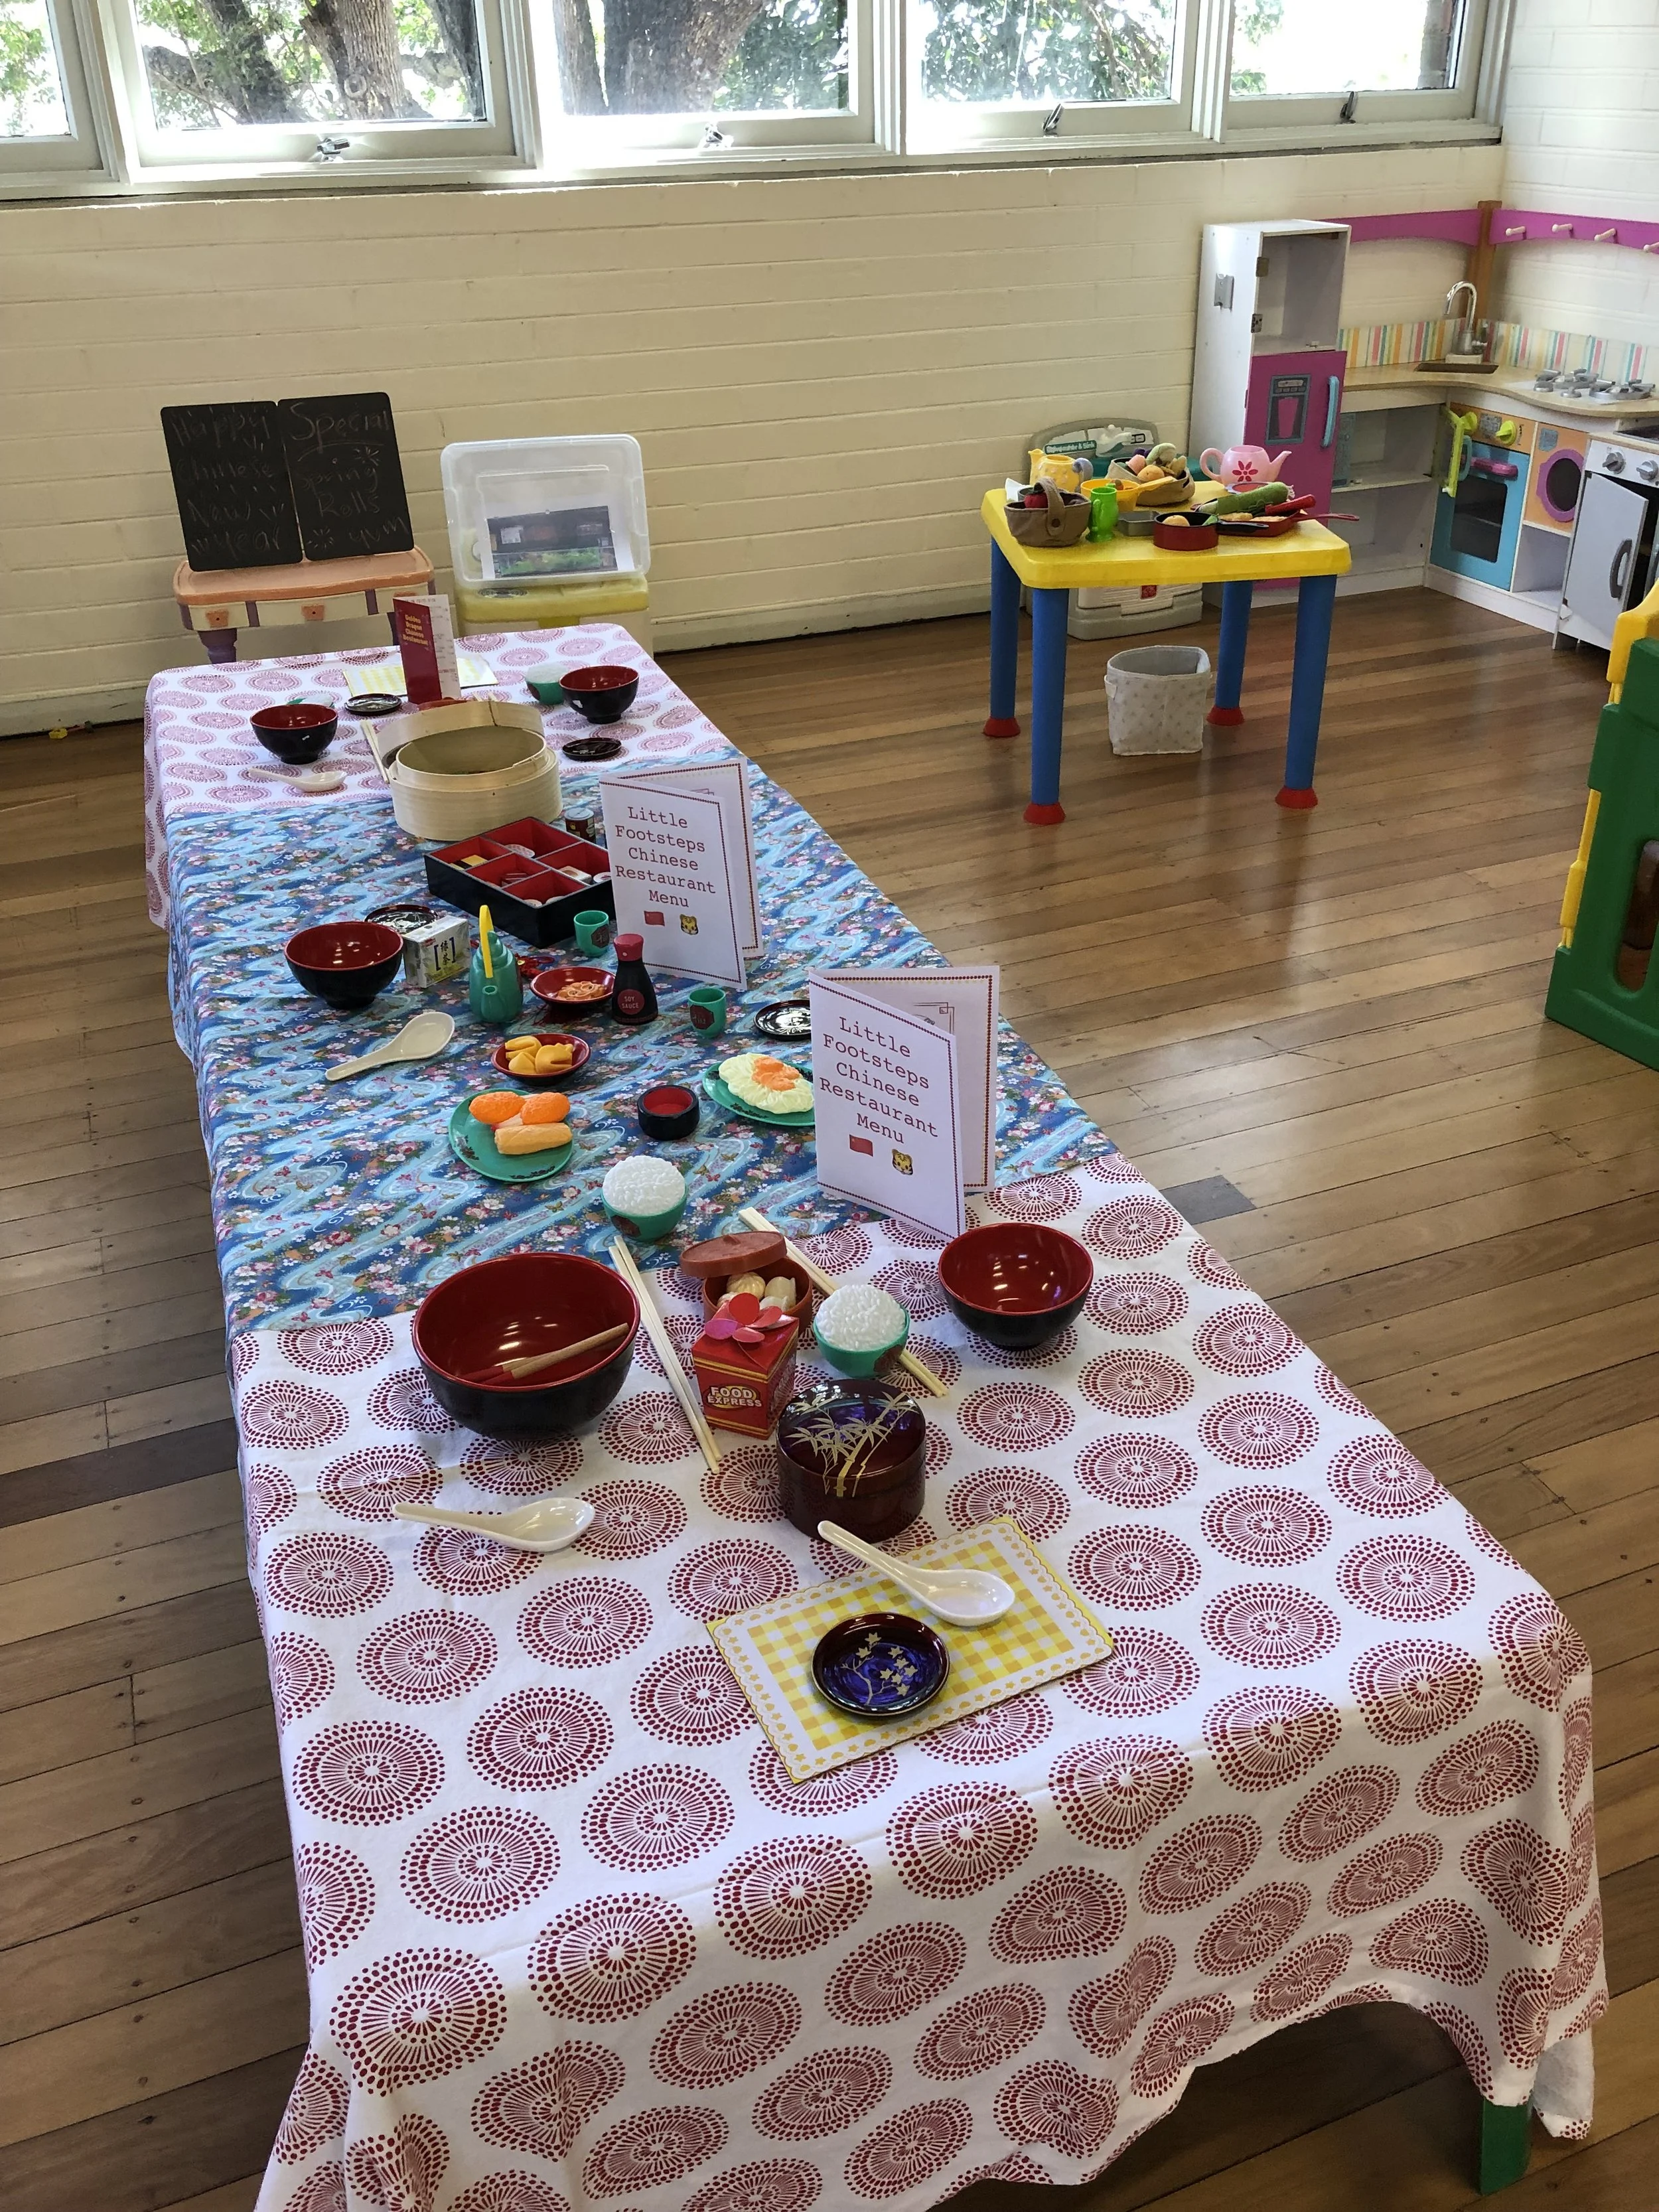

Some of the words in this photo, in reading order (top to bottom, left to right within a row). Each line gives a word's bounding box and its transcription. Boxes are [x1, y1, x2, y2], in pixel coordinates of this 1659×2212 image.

[171, 409, 271, 449] Happy
[289, 402, 390, 454] Special
[317, 490, 381, 518] Rolls
[627, 806, 688, 829] Little
[615, 825, 705, 853] Footsteps
[628, 848, 699, 871] Chinese
[615, 865, 716, 894] Restaurant
[648, 889, 689, 908] Menu
[839, 1016, 911, 1057] Little
[823, 1033, 930, 1089] Footsteps
[836, 1062, 920, 1106] Chinese
[820, 1077, 939, 1138] Restaurant
[857, 1113, 904, 1144] Menu
[707, 1396, 762, 1408] EXPRESS
[710, 1386, 754, 1399] FOOD
